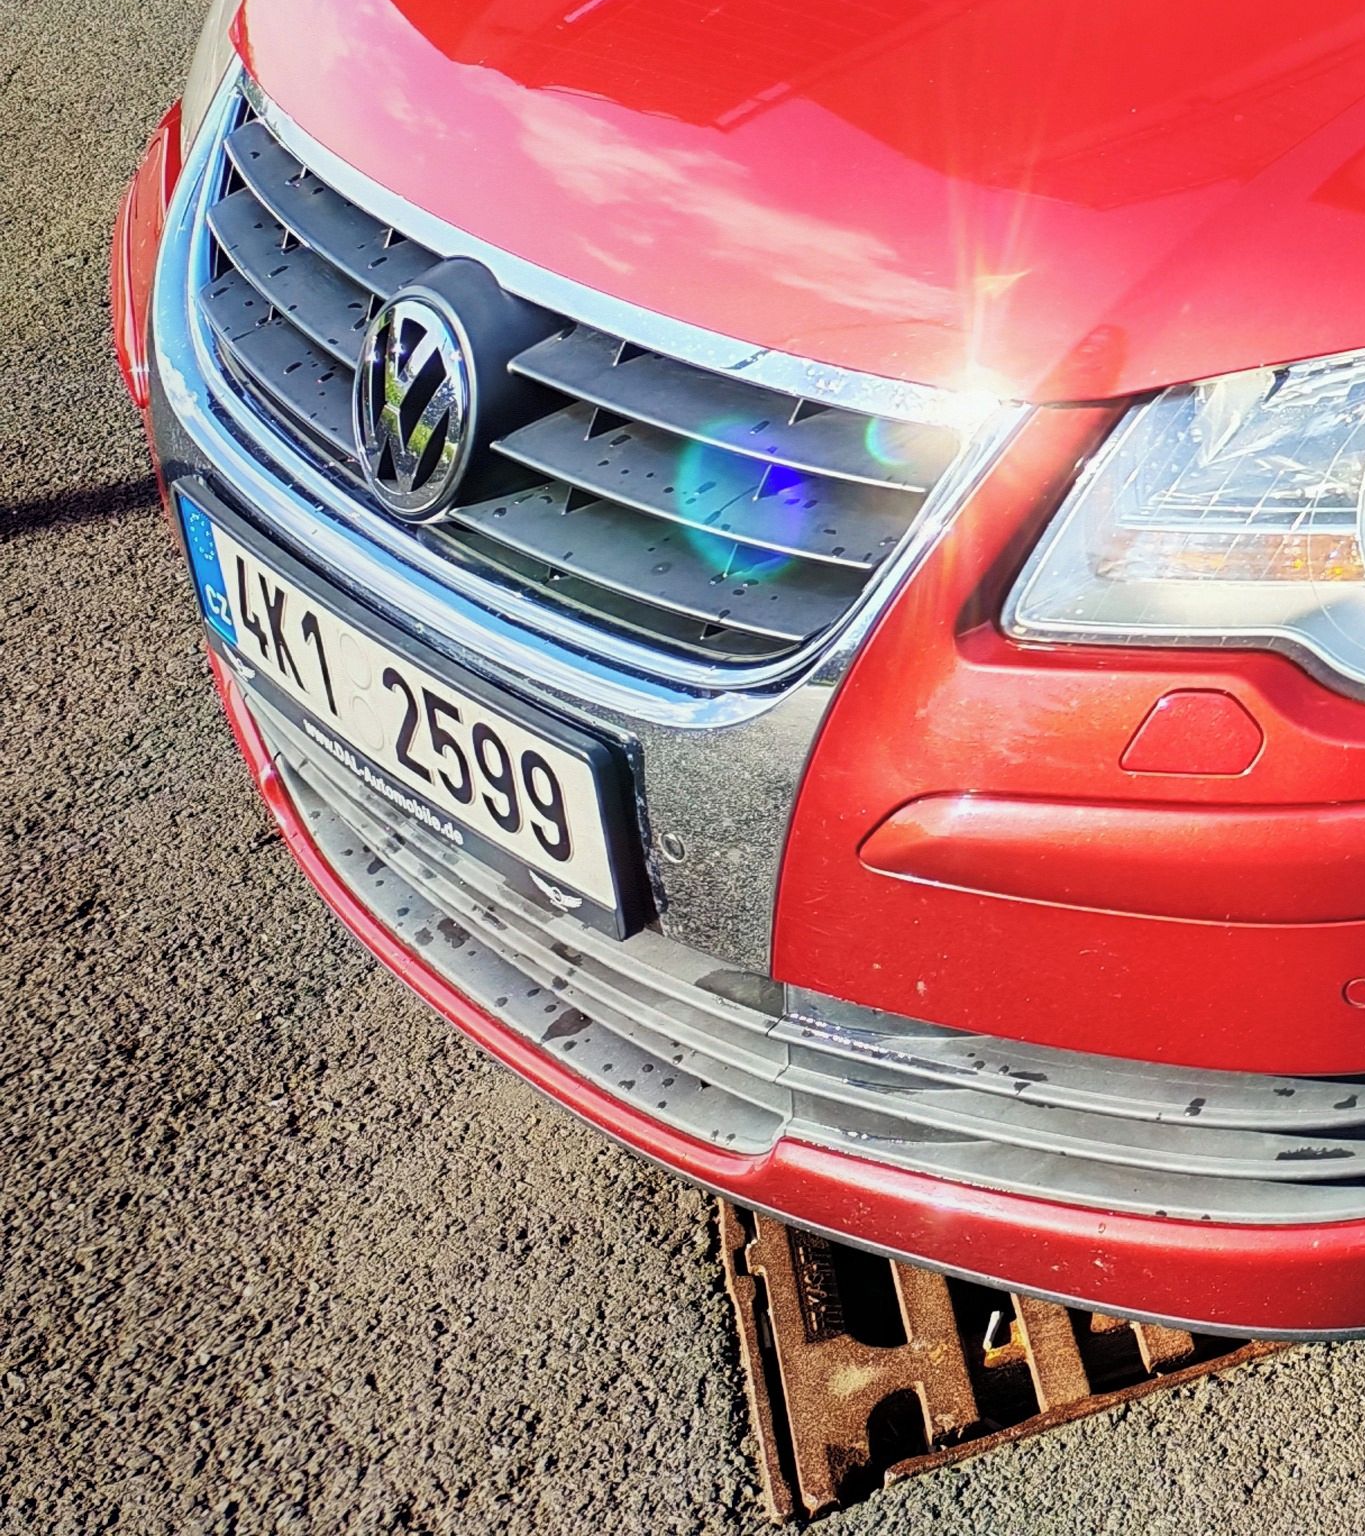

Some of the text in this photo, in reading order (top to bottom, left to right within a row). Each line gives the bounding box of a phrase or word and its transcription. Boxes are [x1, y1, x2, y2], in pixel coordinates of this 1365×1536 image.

[357, 291, 473, 512] VW
[205, 583, 233, 626] CZ
[236, 555, 573, 863] 4K1 2599
